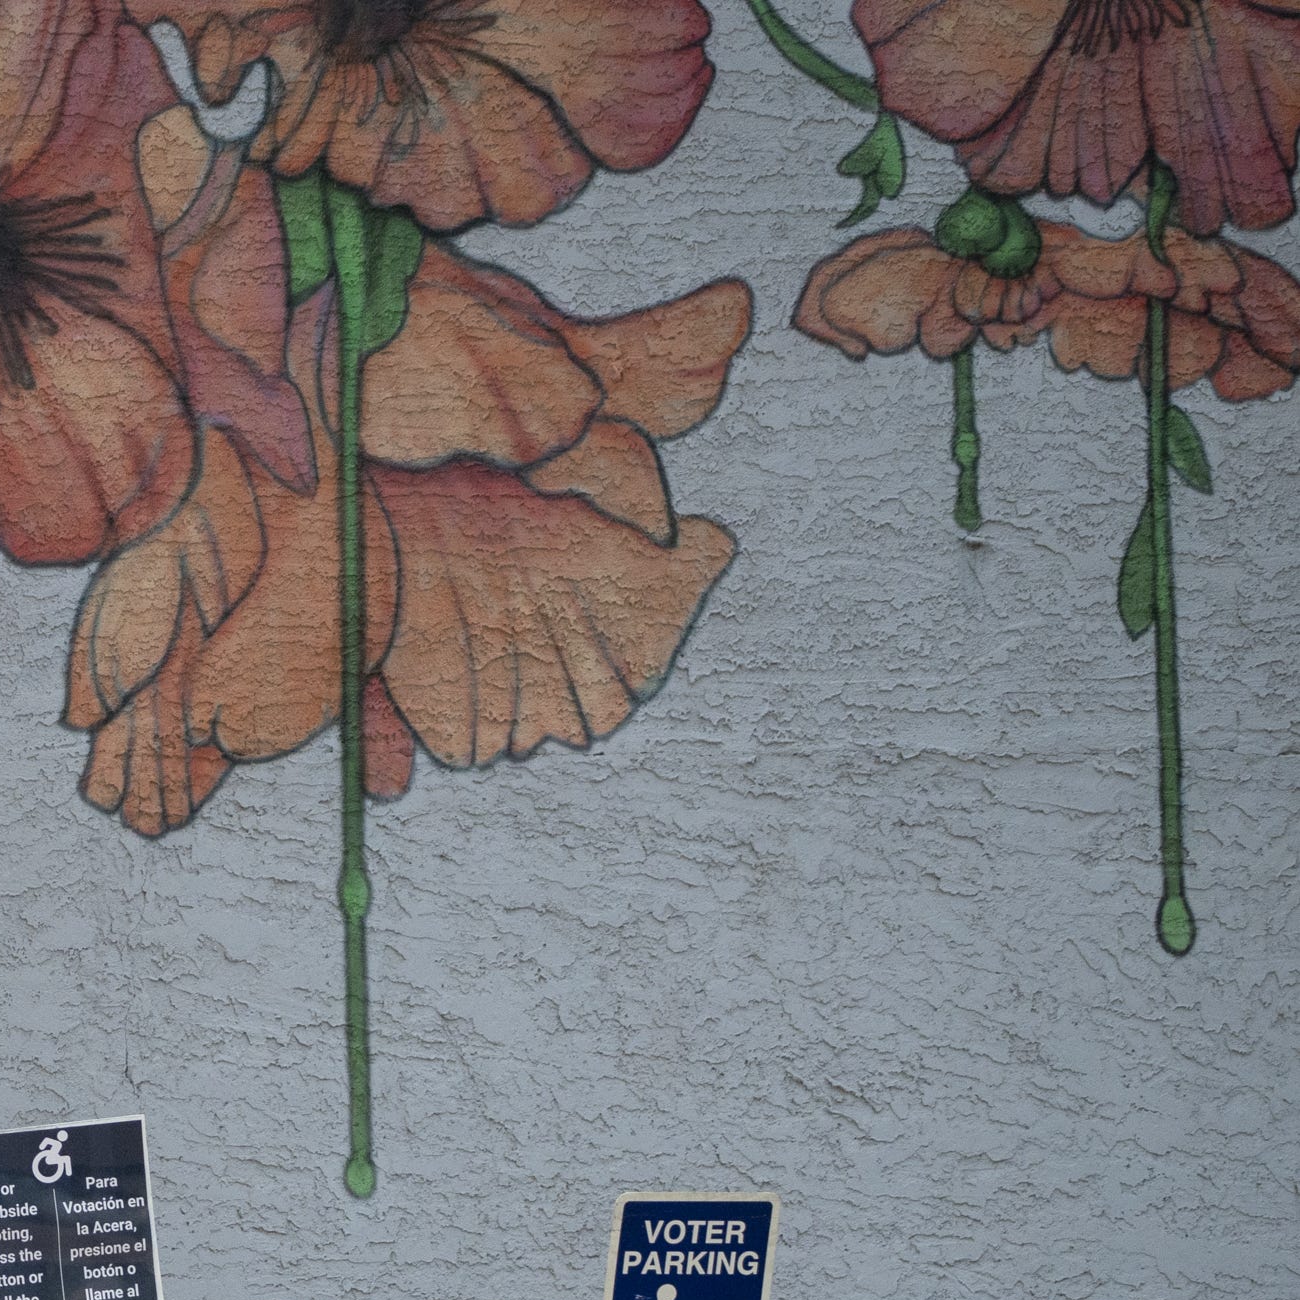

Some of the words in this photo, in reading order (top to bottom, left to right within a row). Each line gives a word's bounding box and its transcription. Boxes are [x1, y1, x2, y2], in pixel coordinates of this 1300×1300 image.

[85, 1176, 119, 1190] Para
[63, 1196, 125, 1215] Votación
[128, 1196, 145, 1208] en
[76, 1222, 90, 1236] la
[92, 1219, 138, 1235] Acera,
[644, 1220, 747, 1245] VOTER
[19, 1249, 42, 1262] the
[70, 1240, 131, 1262] presione
[133, 1238, 147, 1252] el
[622, 1250, 760, 1276] PARKING
[28, 1271, 44, 1284] or
[83, 1264, 124, 1280] botón
[127, 1264, 136, 1276] o
[126, 1284, 140, 1298] al
